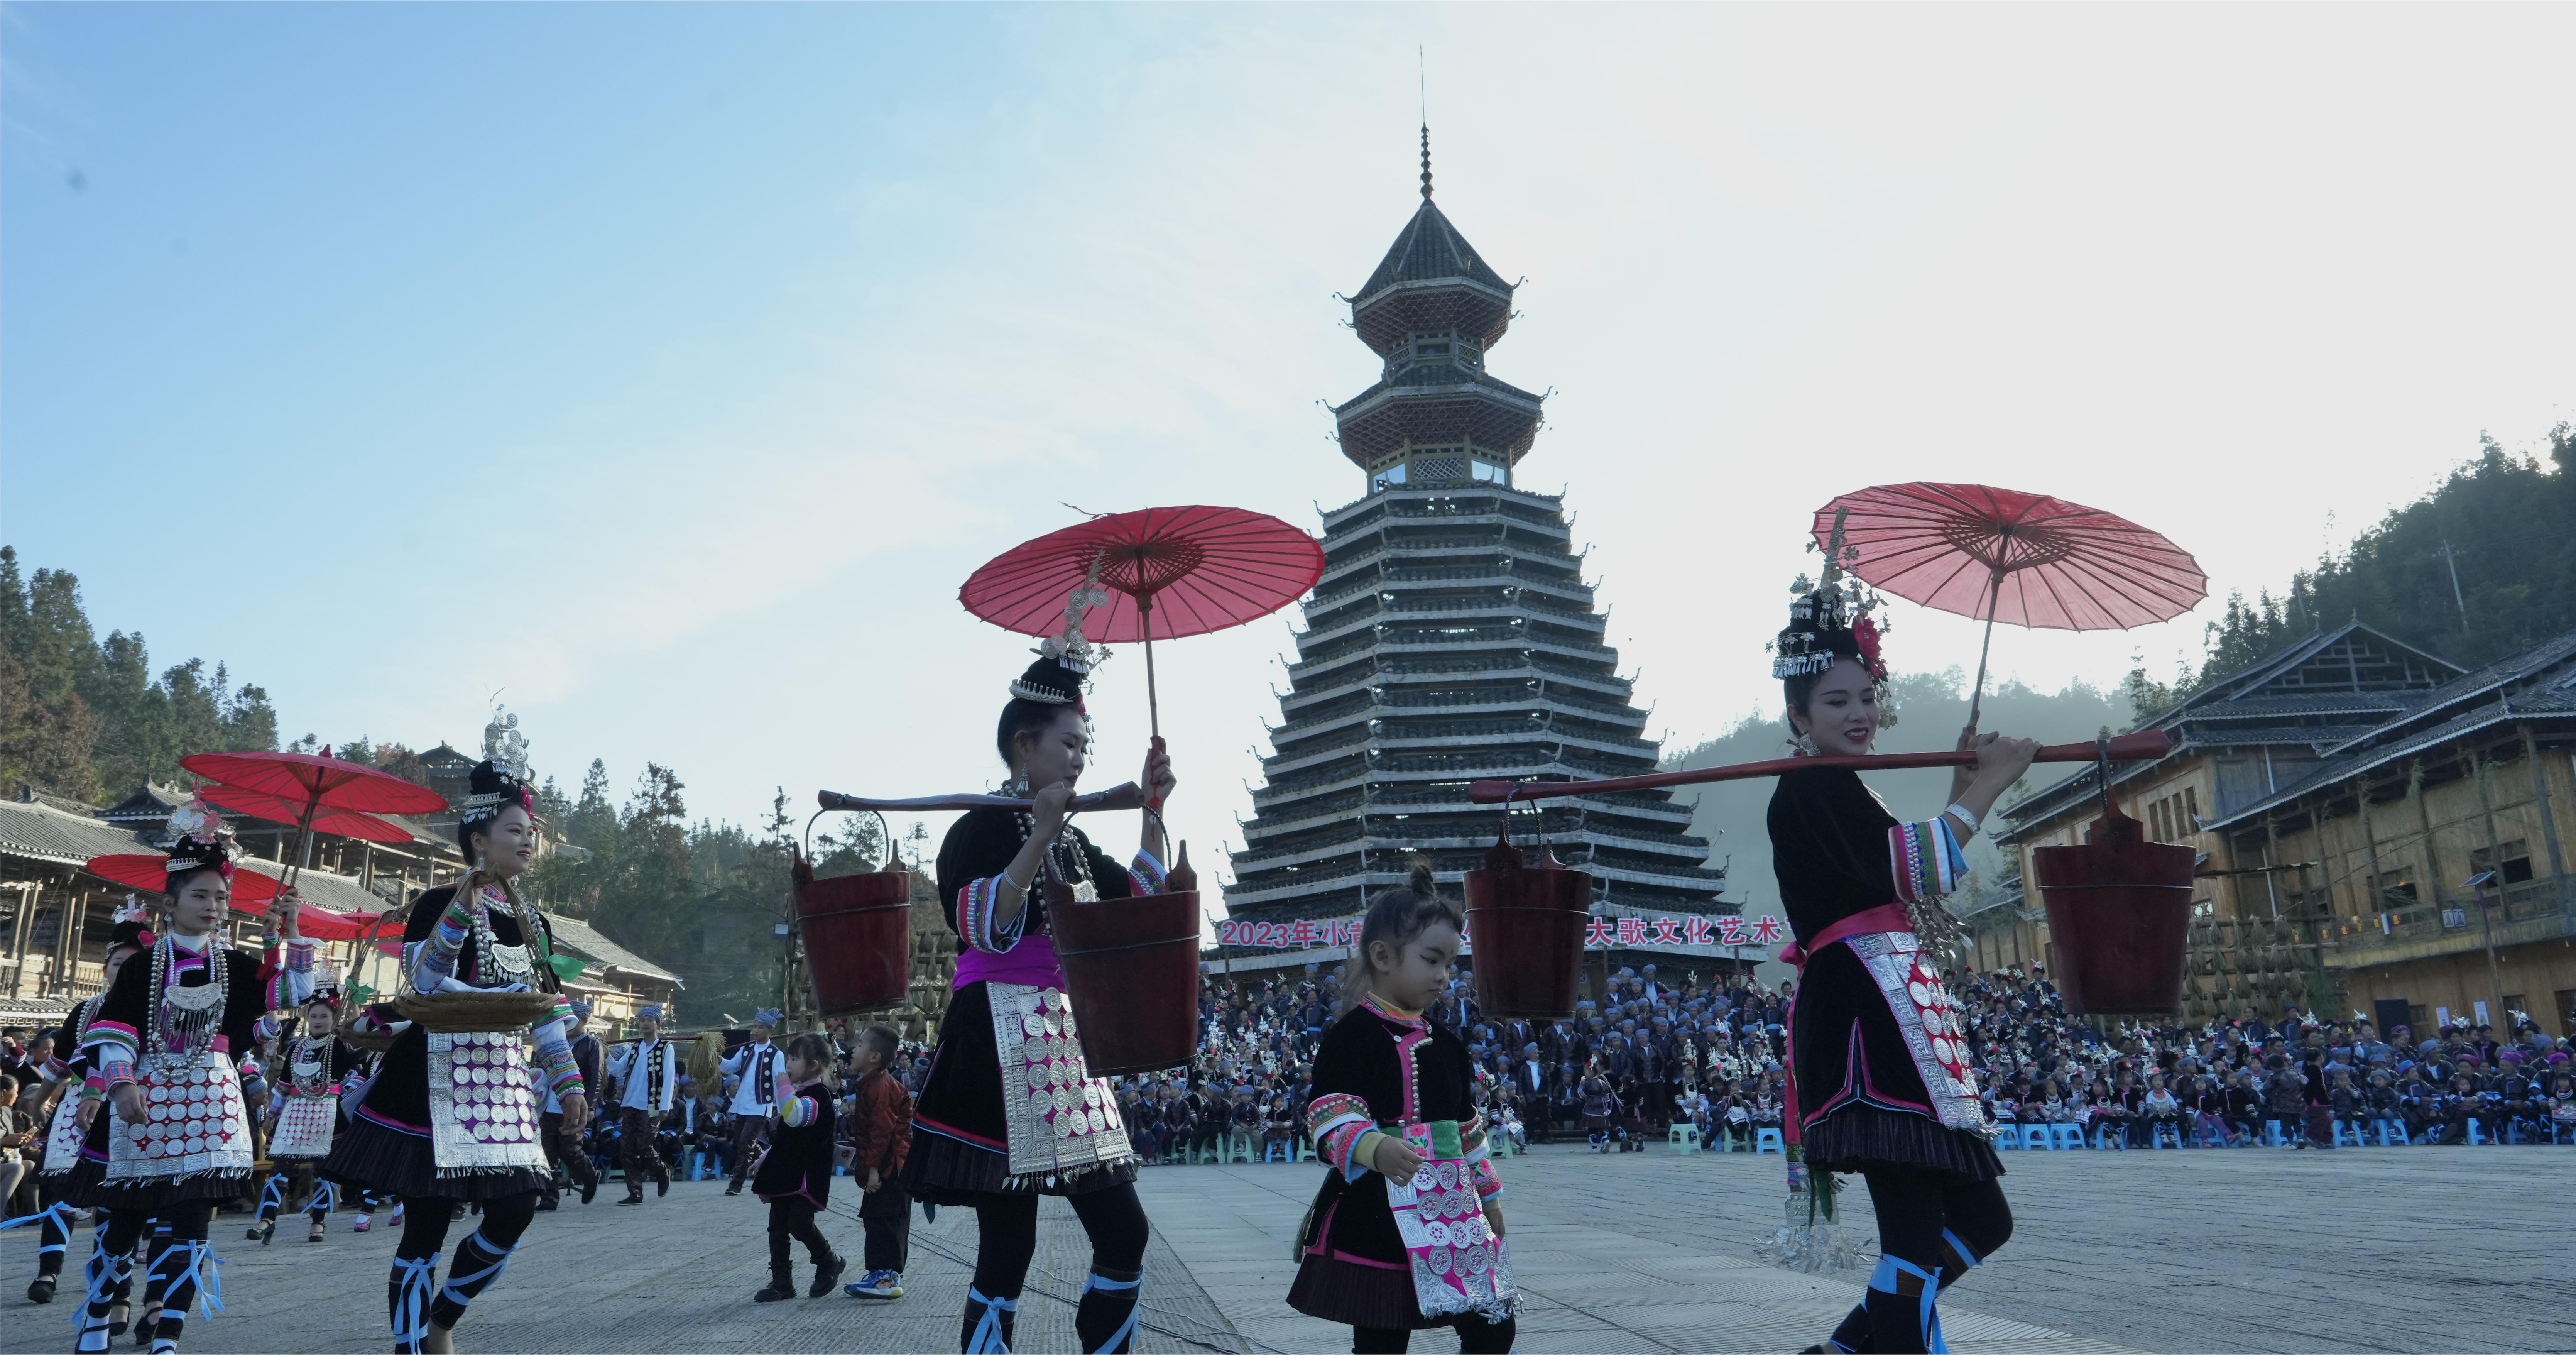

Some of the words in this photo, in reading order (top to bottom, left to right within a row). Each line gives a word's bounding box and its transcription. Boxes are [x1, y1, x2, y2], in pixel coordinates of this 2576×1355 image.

[1586, 915, 1792, 946] 大歌文化艺术
